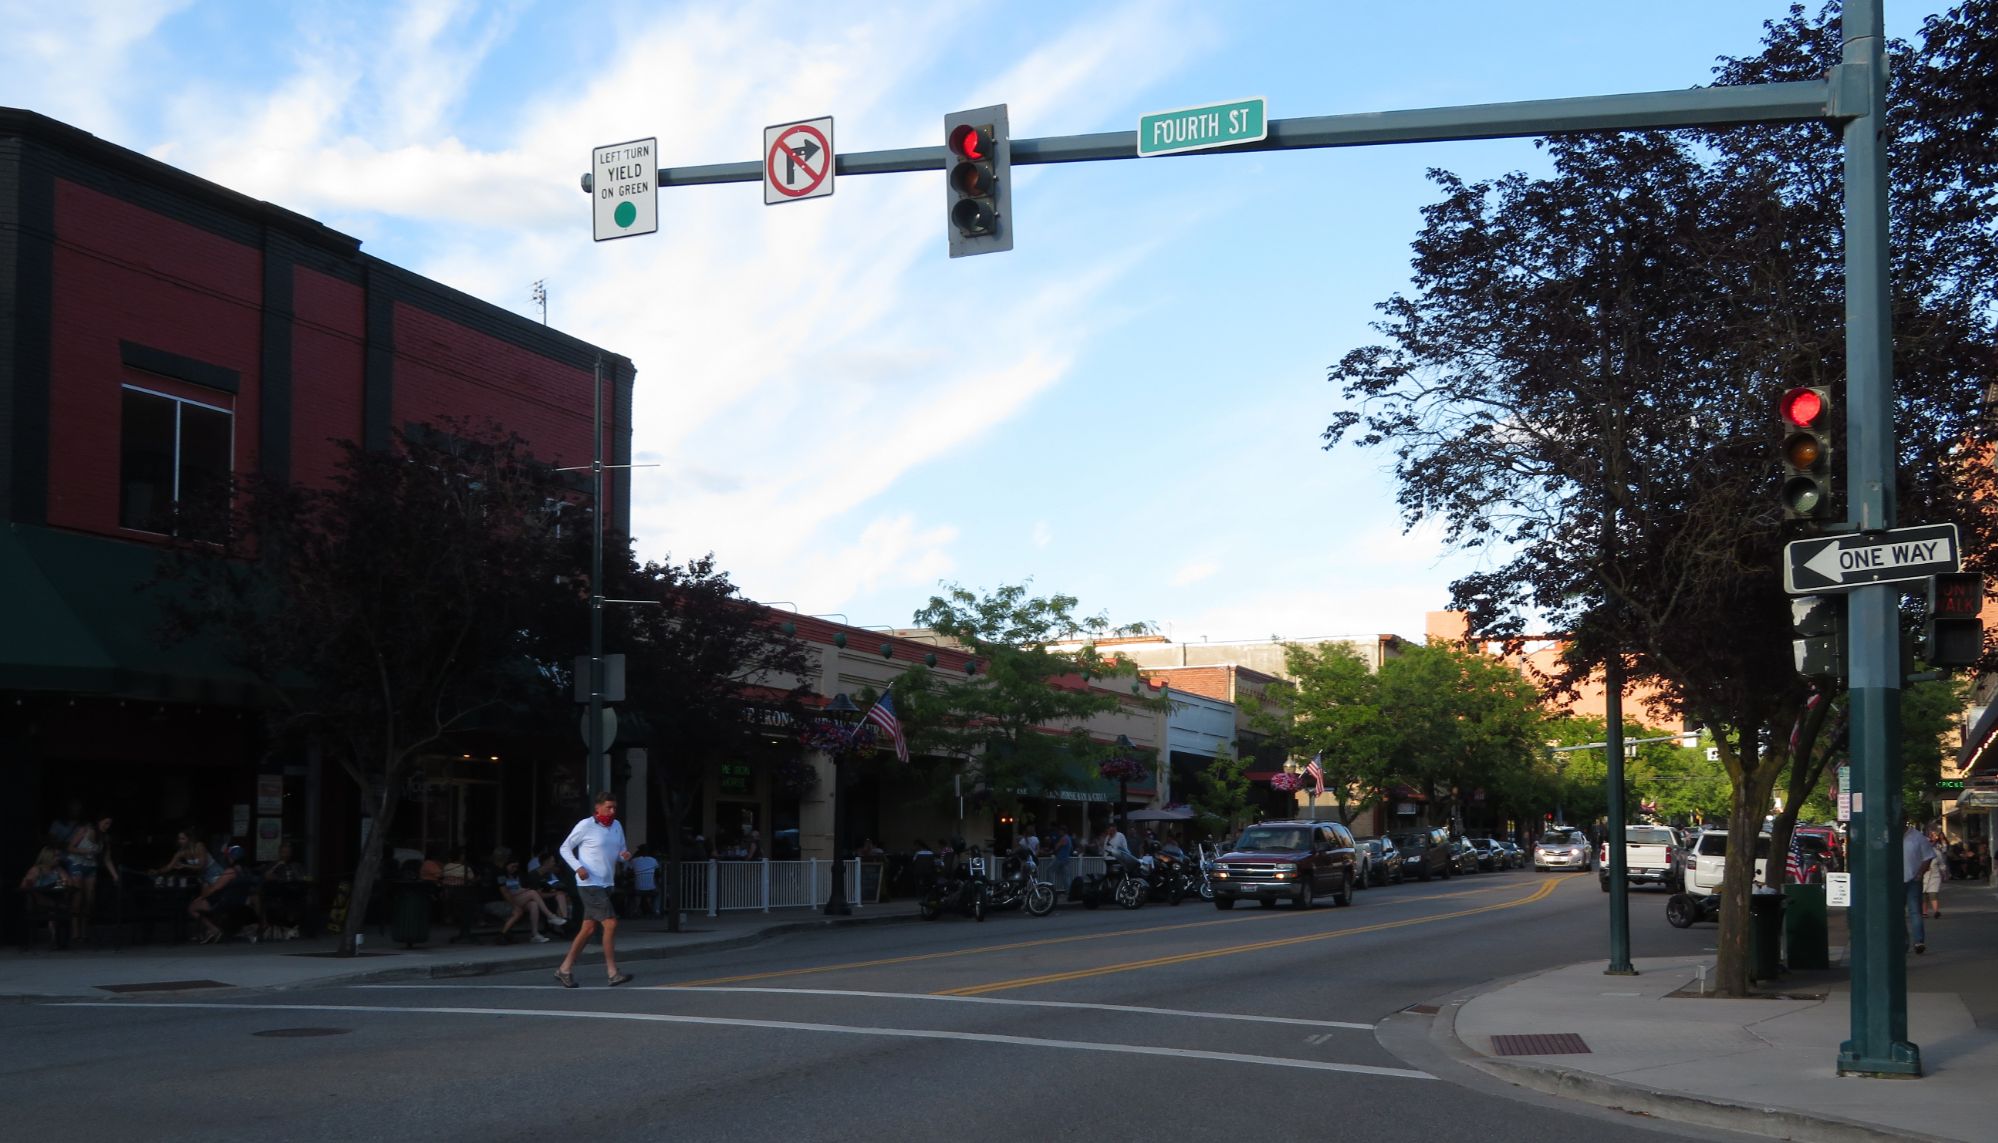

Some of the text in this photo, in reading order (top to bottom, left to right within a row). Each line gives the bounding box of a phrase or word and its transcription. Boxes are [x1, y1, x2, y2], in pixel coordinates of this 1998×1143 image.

[1153, 108, 1249, 145] FOURTH ST
[600, 146, 649, 164] LEFT TURN
[607, 163, 642, 182] YIELD
[601, 182, 648, 199] ON GREEN
[1839, 541, 1938, 570] ONE WAY
